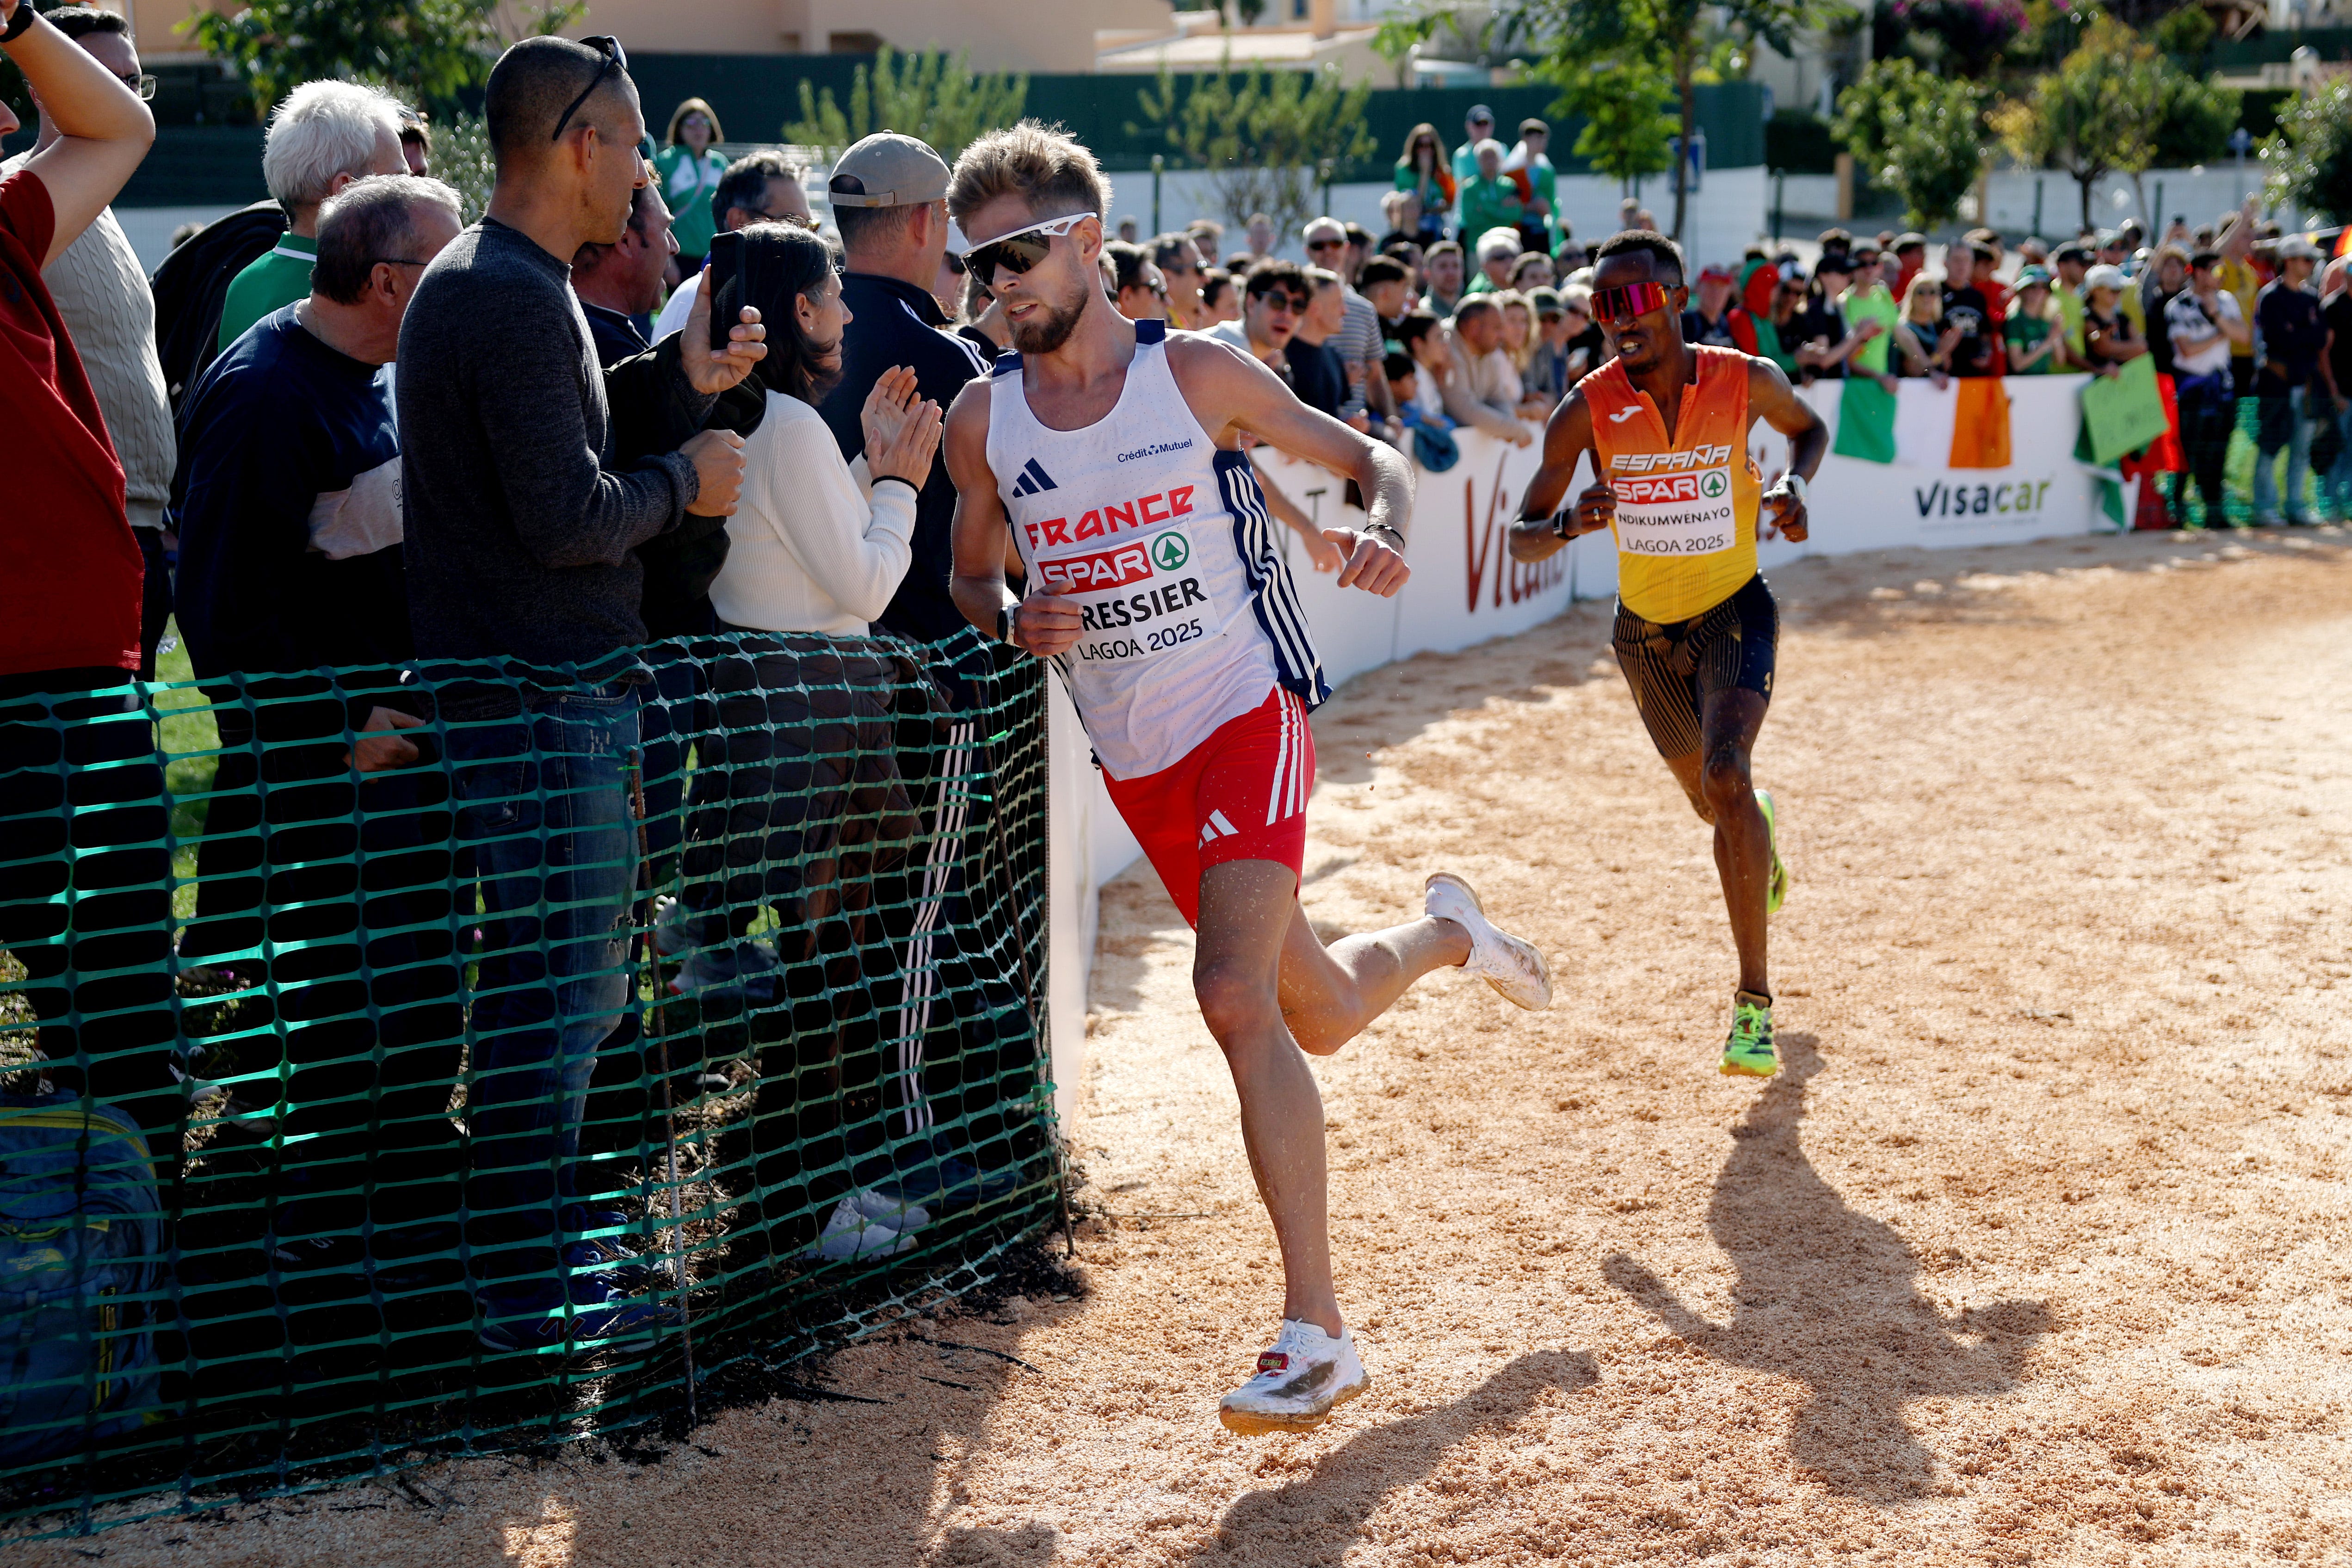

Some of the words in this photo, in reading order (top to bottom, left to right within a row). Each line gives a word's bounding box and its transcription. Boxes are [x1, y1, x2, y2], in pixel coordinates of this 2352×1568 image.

[1117, 448, 1148, 463] Crédit
[1159, 438, 1193, 453] Mutuel
[1610, 443, 1733, 471] ESPAÑA
[1612, 477, 1698, 502] SPAR
[1024, 484, 1194, 550] FRANCE
[1618, 506, 1730, 526] NDIKUMWENAYO
[1626, 537, 1682, 552] LAGOA
[1685, 533, 1724, 551] 2025
[1044, 549, 1148, 588] SPAR
[1081, 577, 1208, 631] RESSIER
[1077, 638, 1145, 660] LAGOA
[1147, 618, 1203, 652] 2025
